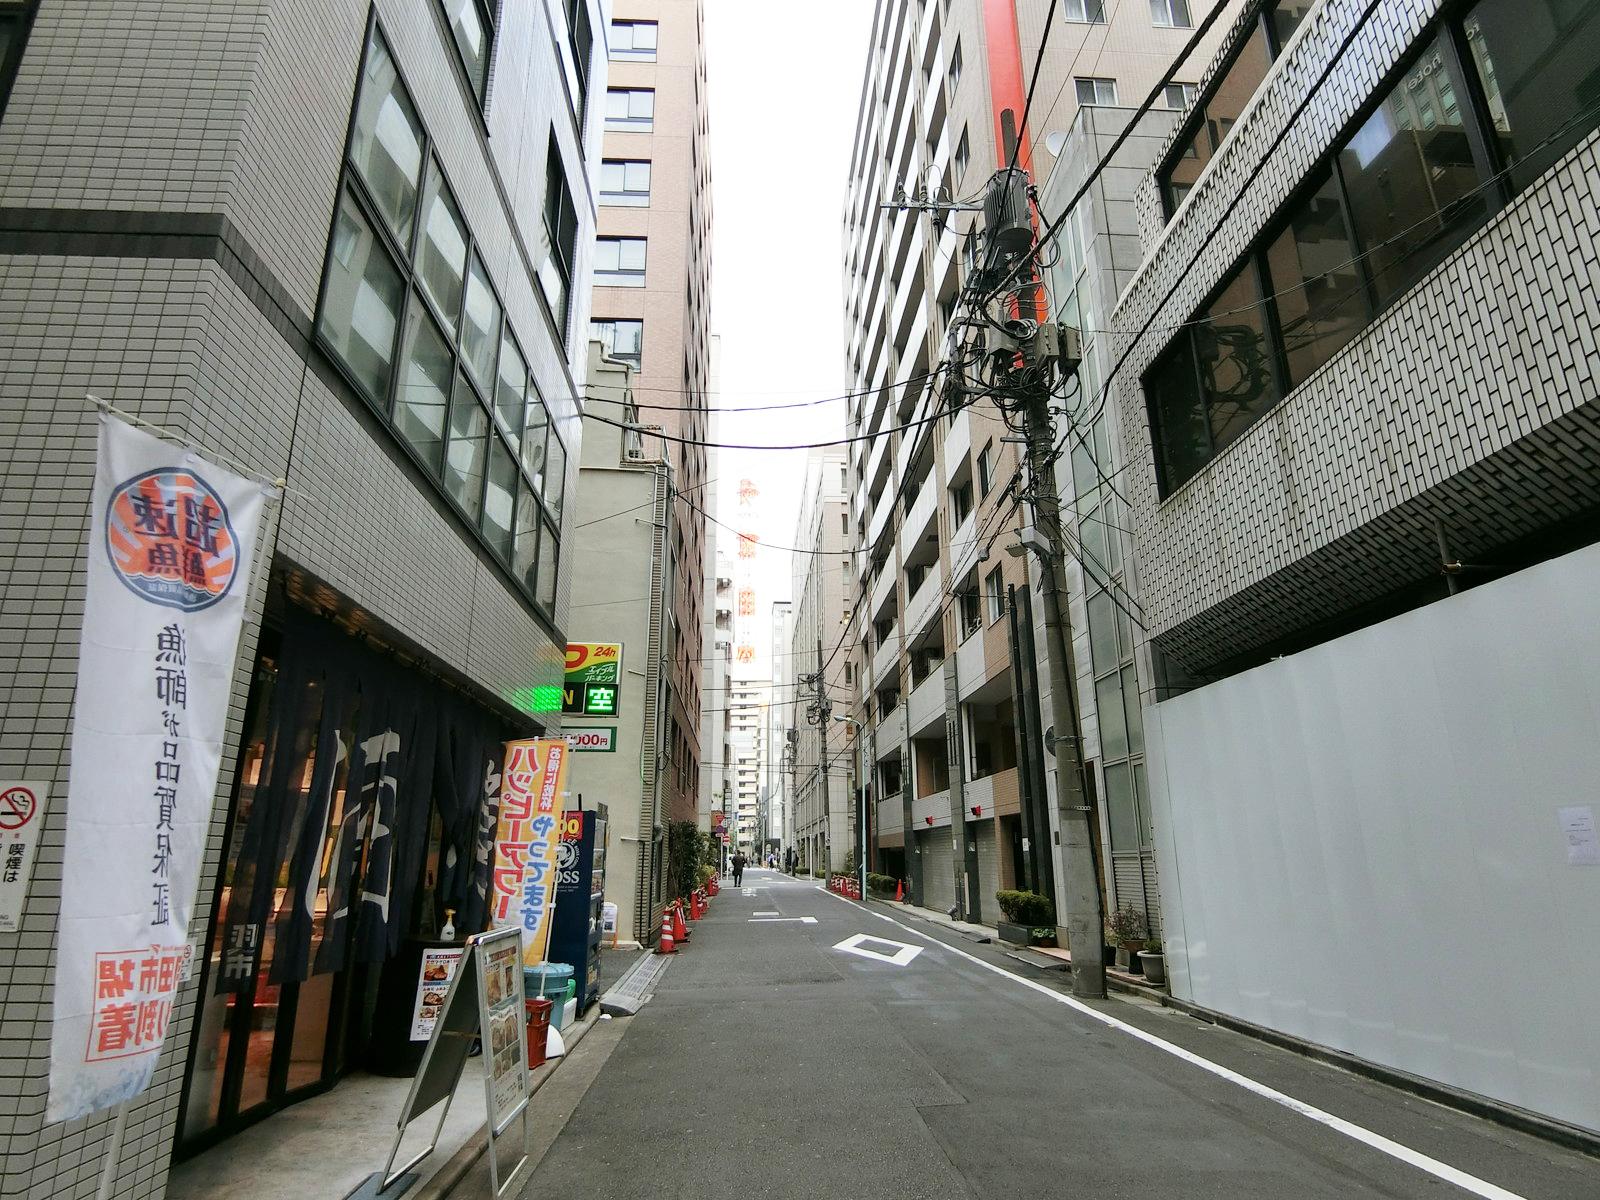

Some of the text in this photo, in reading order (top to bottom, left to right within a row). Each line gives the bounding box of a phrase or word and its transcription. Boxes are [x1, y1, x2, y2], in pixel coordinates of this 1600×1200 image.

[593, 646, 616, 657] 24h
[587, 687, 614, 711] 空
[3, 843, 26, 883] 喫煙は
